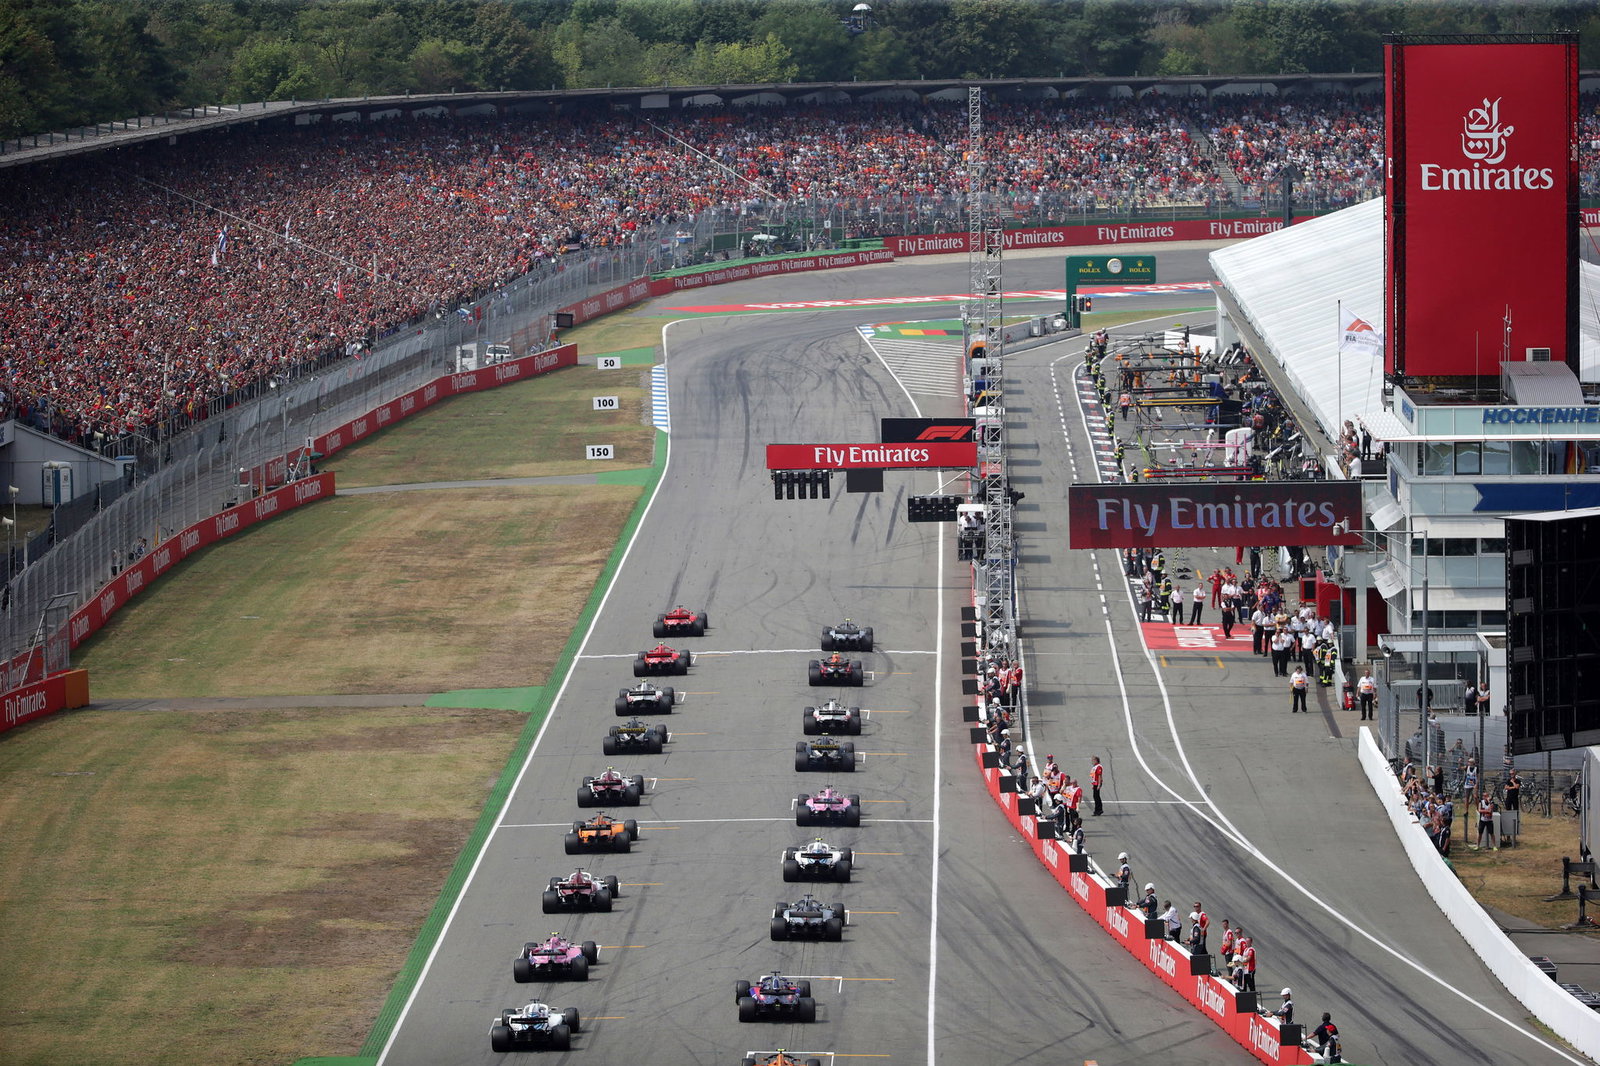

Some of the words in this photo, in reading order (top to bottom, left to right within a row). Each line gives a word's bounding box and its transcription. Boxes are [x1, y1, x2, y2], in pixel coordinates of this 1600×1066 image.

[1420, 162, 1554, 191] Emirates
[1015, 230, 1065, 245] Emirates
[1097, 227, 1118, 242] Fly
[1120, 224, 1174, 239] Emirates
[1210, 222, 1231, 237] Fly
[1233, 220, 1284, 234] Emirate
[898, 239, 915, 254] Fly
[918, 236, 964, 251] Emirates
[781, 261, 790, 271] Fly
[790, 258, 815, 270] Emirates
[818, 257, 829, 268] Fly
[829, 255, 856, 267] Emirates
[859, 253, 869, 263] Fly
[759, 262, 779, 273] Emirates
[675, 279, 683, 288] Fly
[683, 275, 703, 286] Emirates
[534, 356, 542, 371] Fly
[541, 352, 558, 369] Emirates
[603, 359, 615, 368] 50
[459, 372, 477, 388] Emirates
[495, 366, 503, 382] Fly
[502, 363, 520, 379] Emirates
[596, 399, 614, 408] 100
[590, 448, 609, 457] 150
[814, 447, 845, 466] Fly
[848, 445, 930, 463] Emirates
[294, 483, 303, 504] Fly
[302, 479, 321, 502] Emirates
[1096, 498, 1159, 537] Fly
[1168, 495, 1336, 529] Emirates
[5, 698, 16, 725] Fly
[16, 689, 47, 718] Emirates
[1150, 938, 1158, 969] Fly
[1157, 943, 1176, 978] Emirates
[1197, 975, 1205, 1008] Fly
[1205, 980, 1225, 1018] Emirates
[1249, 1017, 1258, 1051] Fly
[1257, 1023, 1280, 1062] Emirates
